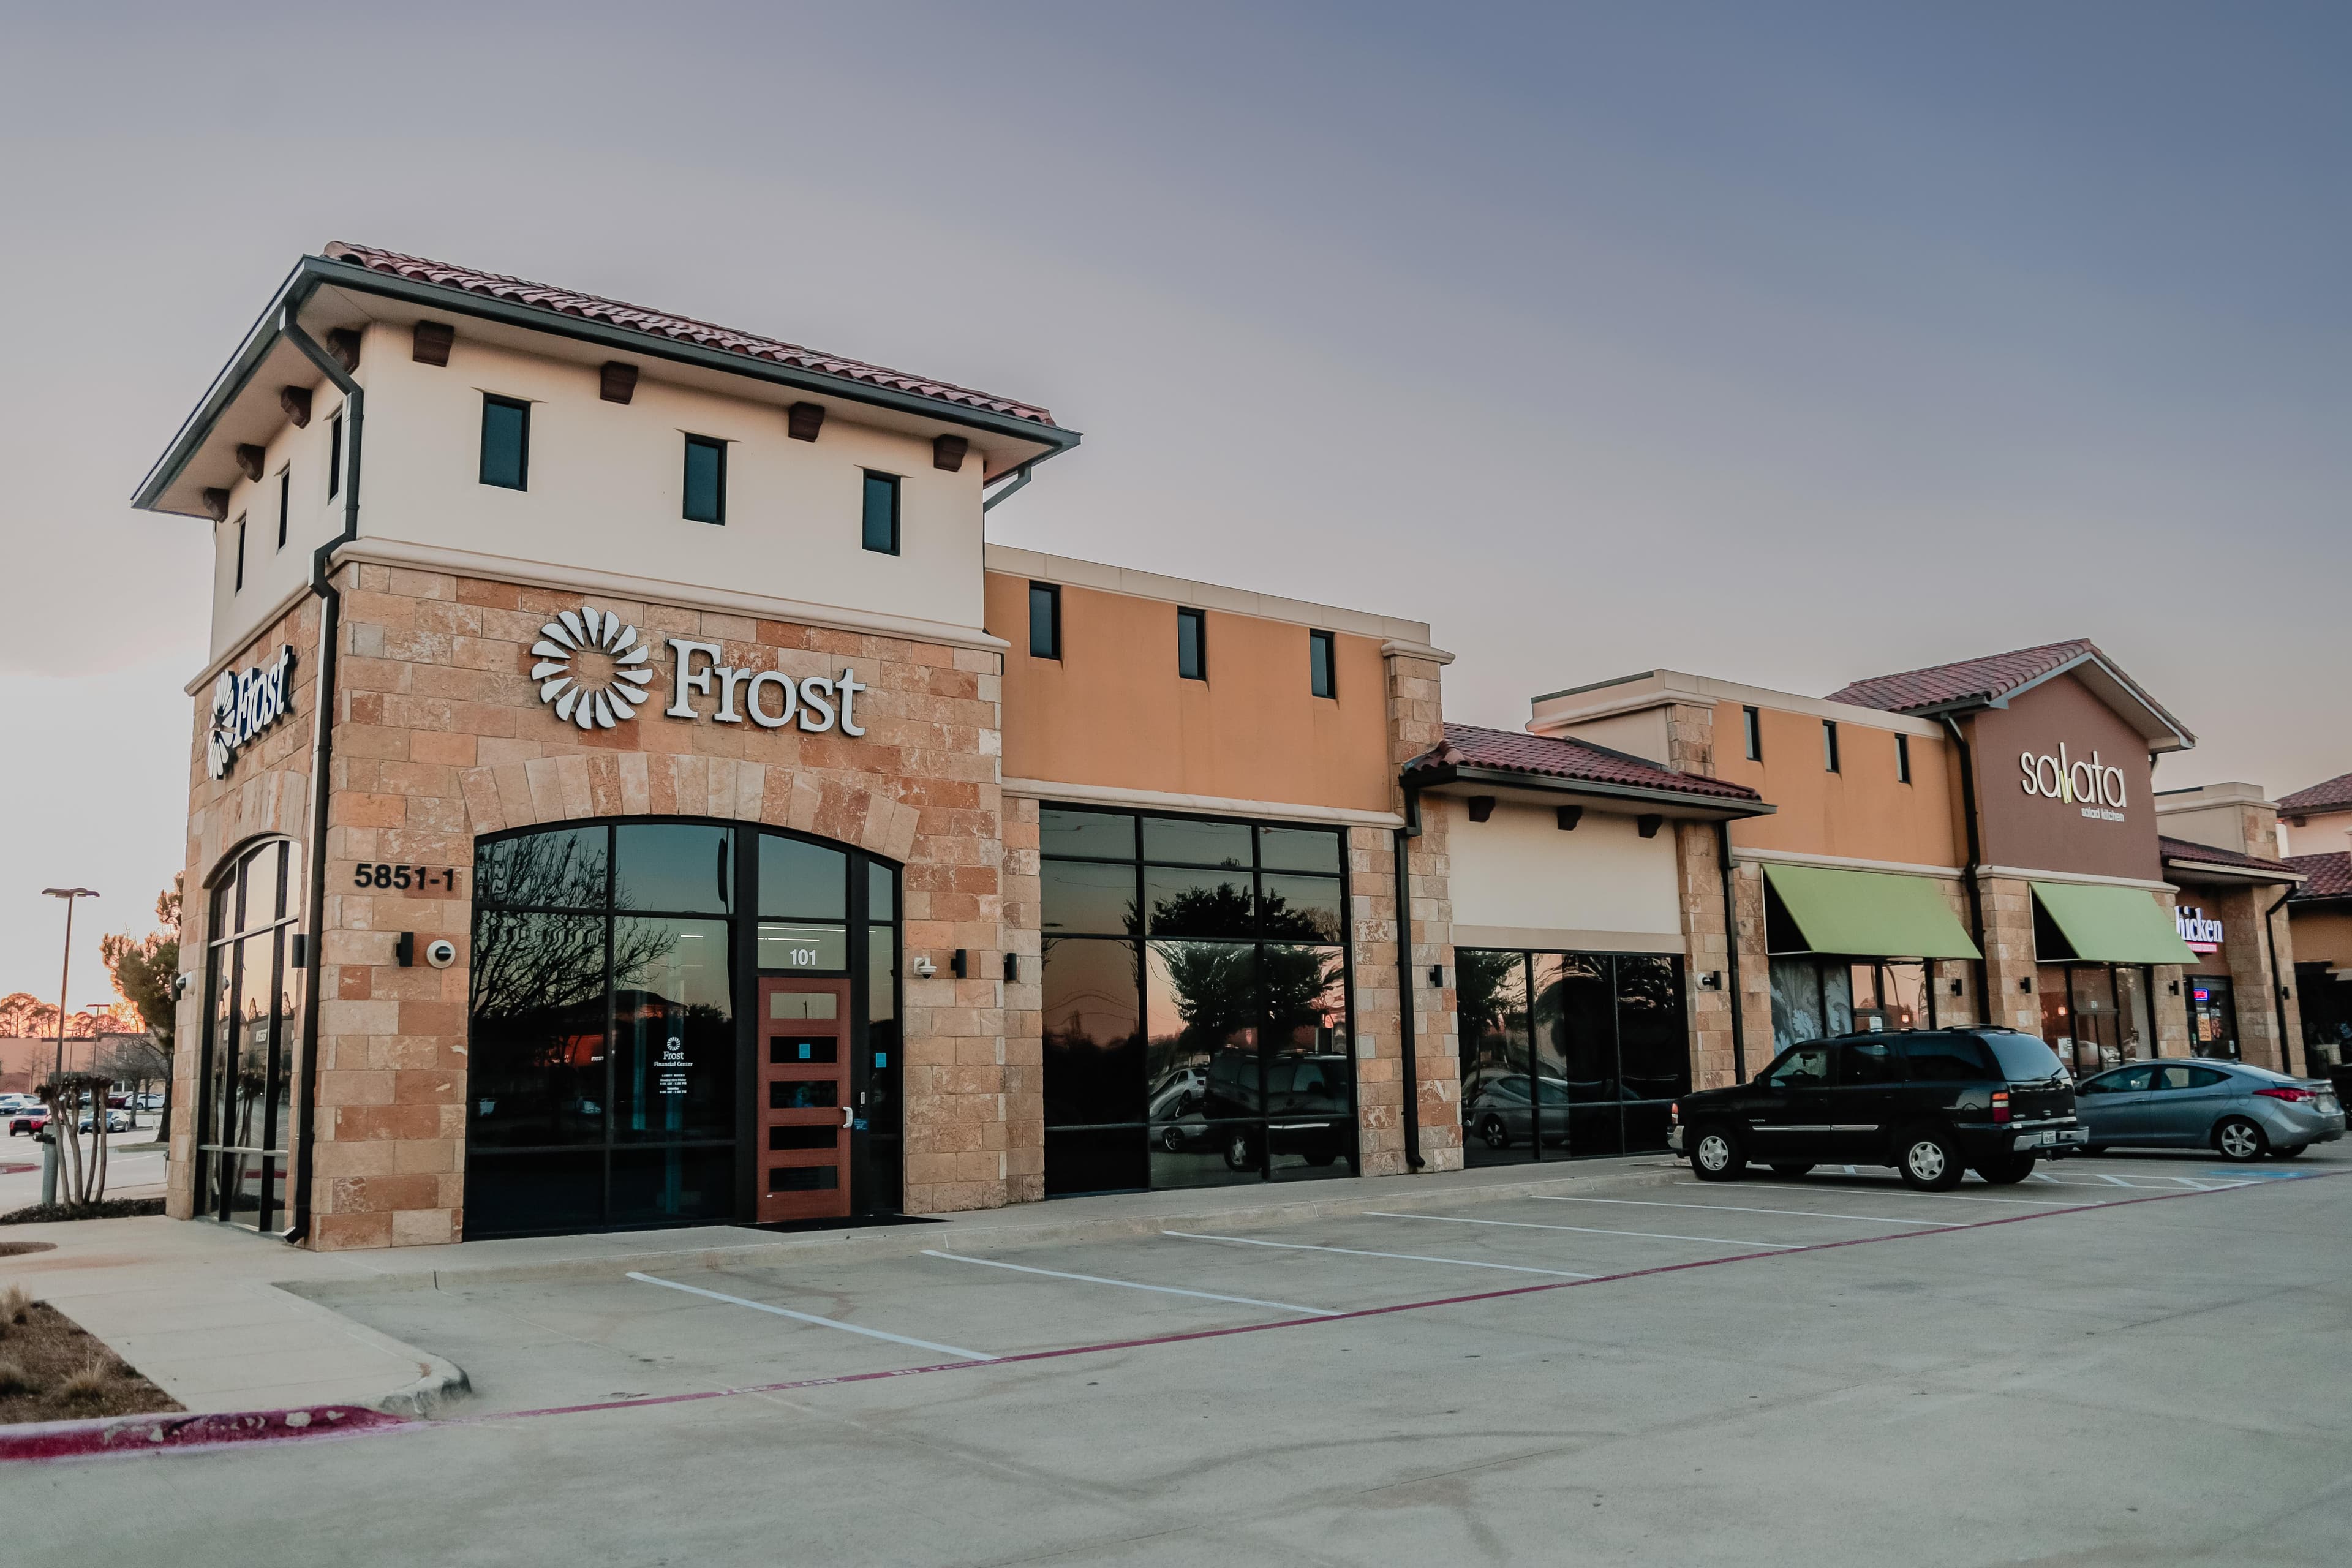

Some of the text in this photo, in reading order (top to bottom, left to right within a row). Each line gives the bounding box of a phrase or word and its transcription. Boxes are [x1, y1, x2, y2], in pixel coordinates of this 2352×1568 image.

[232, 644, 291, 748] Frost
[666, 638, 867, 736] Frost
[2021, 742, 2127, 808] salata
[2081, 807, 2125, 823] salad kitchen
[354, 863, 454, 891] 5851-1
[2174, 905, 2224, 943] hicken
[790, 949, 816, 966] 101
[663, 1050, 684, 1060] Frost
